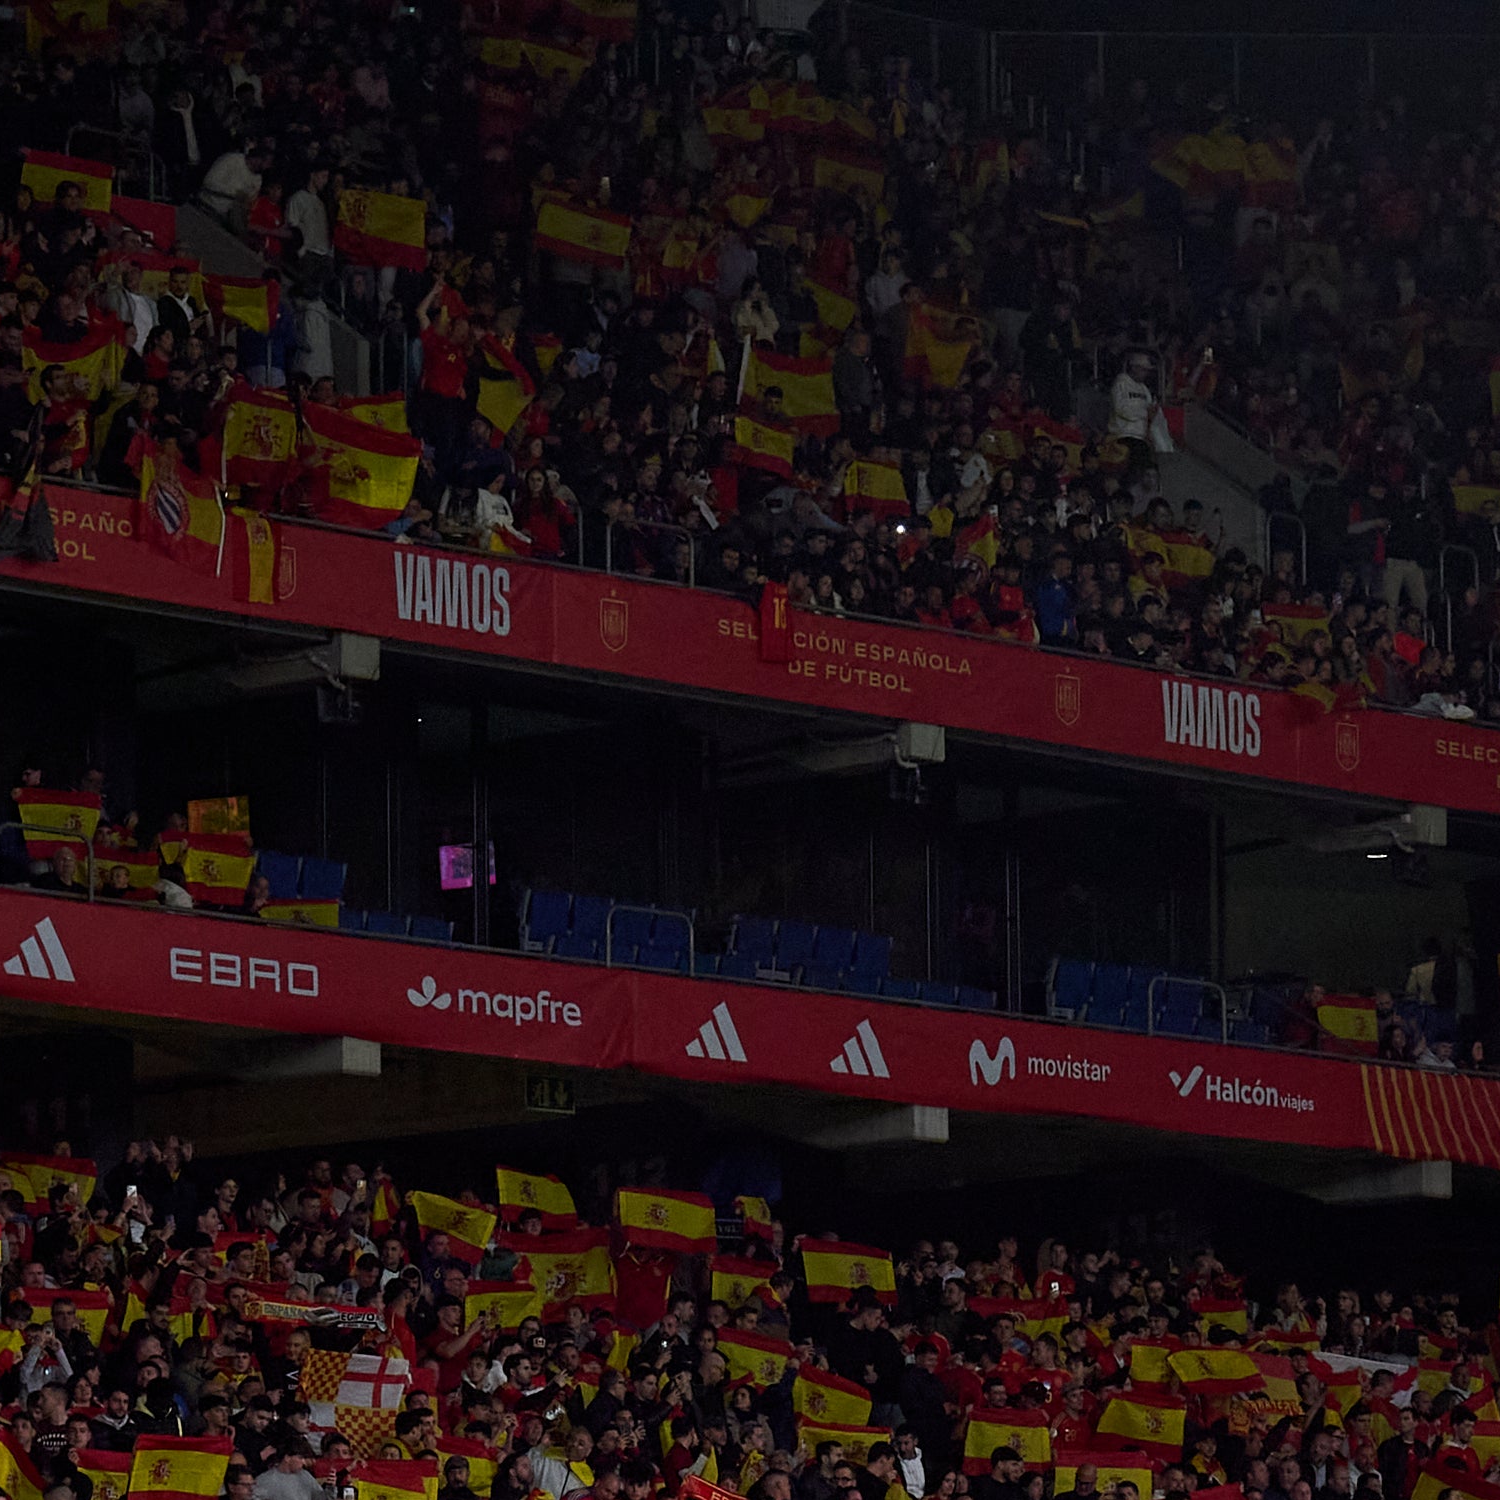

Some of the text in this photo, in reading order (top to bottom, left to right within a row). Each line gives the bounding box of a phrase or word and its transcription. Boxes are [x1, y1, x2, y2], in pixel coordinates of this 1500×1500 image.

[393, 550, 512, 636] VAMOS
[717, 617, 973, 676] SELCIÓN ESPAÑOLA
[788, 659, 913, 693] DE FÚTBOL
[1161, 678, 1263, 759] VAMOS
[169, 946, 320, 998] EBRO
[457, 988, 583, 1028] mapfre
[1027, 1053, 1112, 1083] movistar
[1205, 1073, 1315, 1113] Halcón viajes
